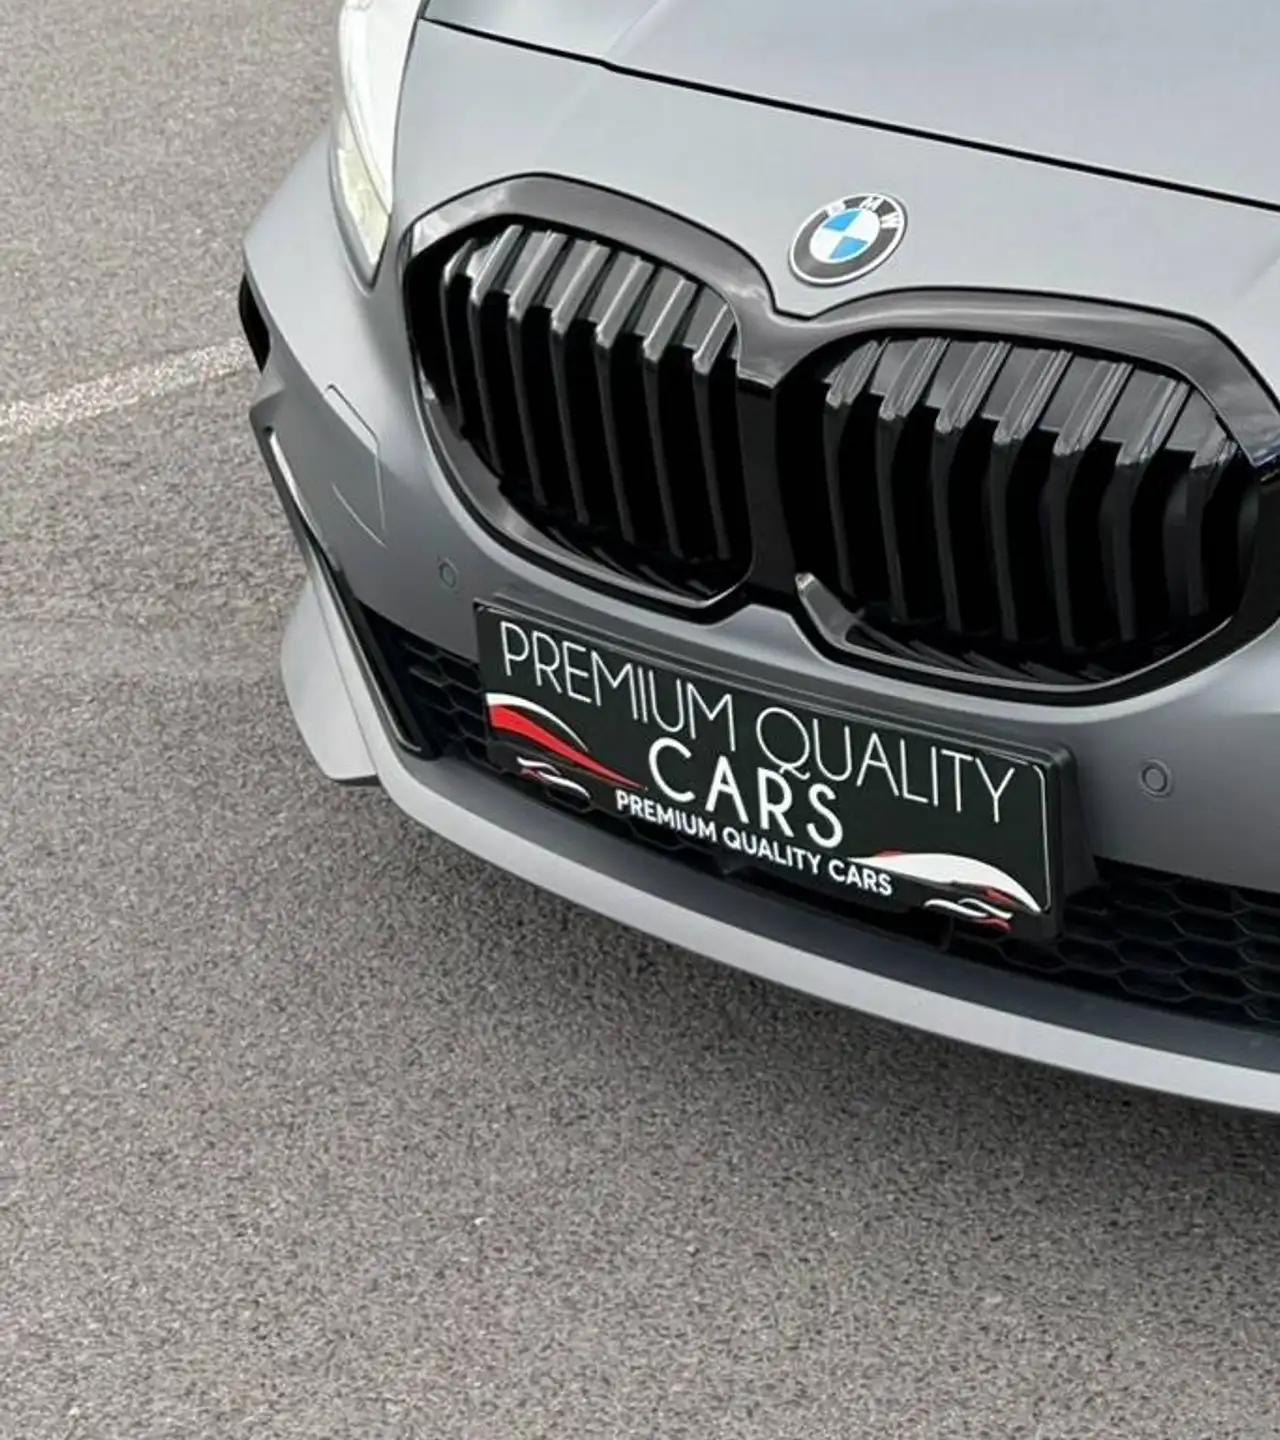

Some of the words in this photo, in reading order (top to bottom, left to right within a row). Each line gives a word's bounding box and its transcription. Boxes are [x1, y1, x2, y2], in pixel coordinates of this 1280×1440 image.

[499, 619, 737, 753] PREMIUM
[755, 706, 1016, 824] QUALITY
[614, 787, 718, 843] PREMIUM
[721, 825, 822, 875] QUALITY
[827, 856, 894, 898] CARS
[648, 736, 844, 850] CARS
